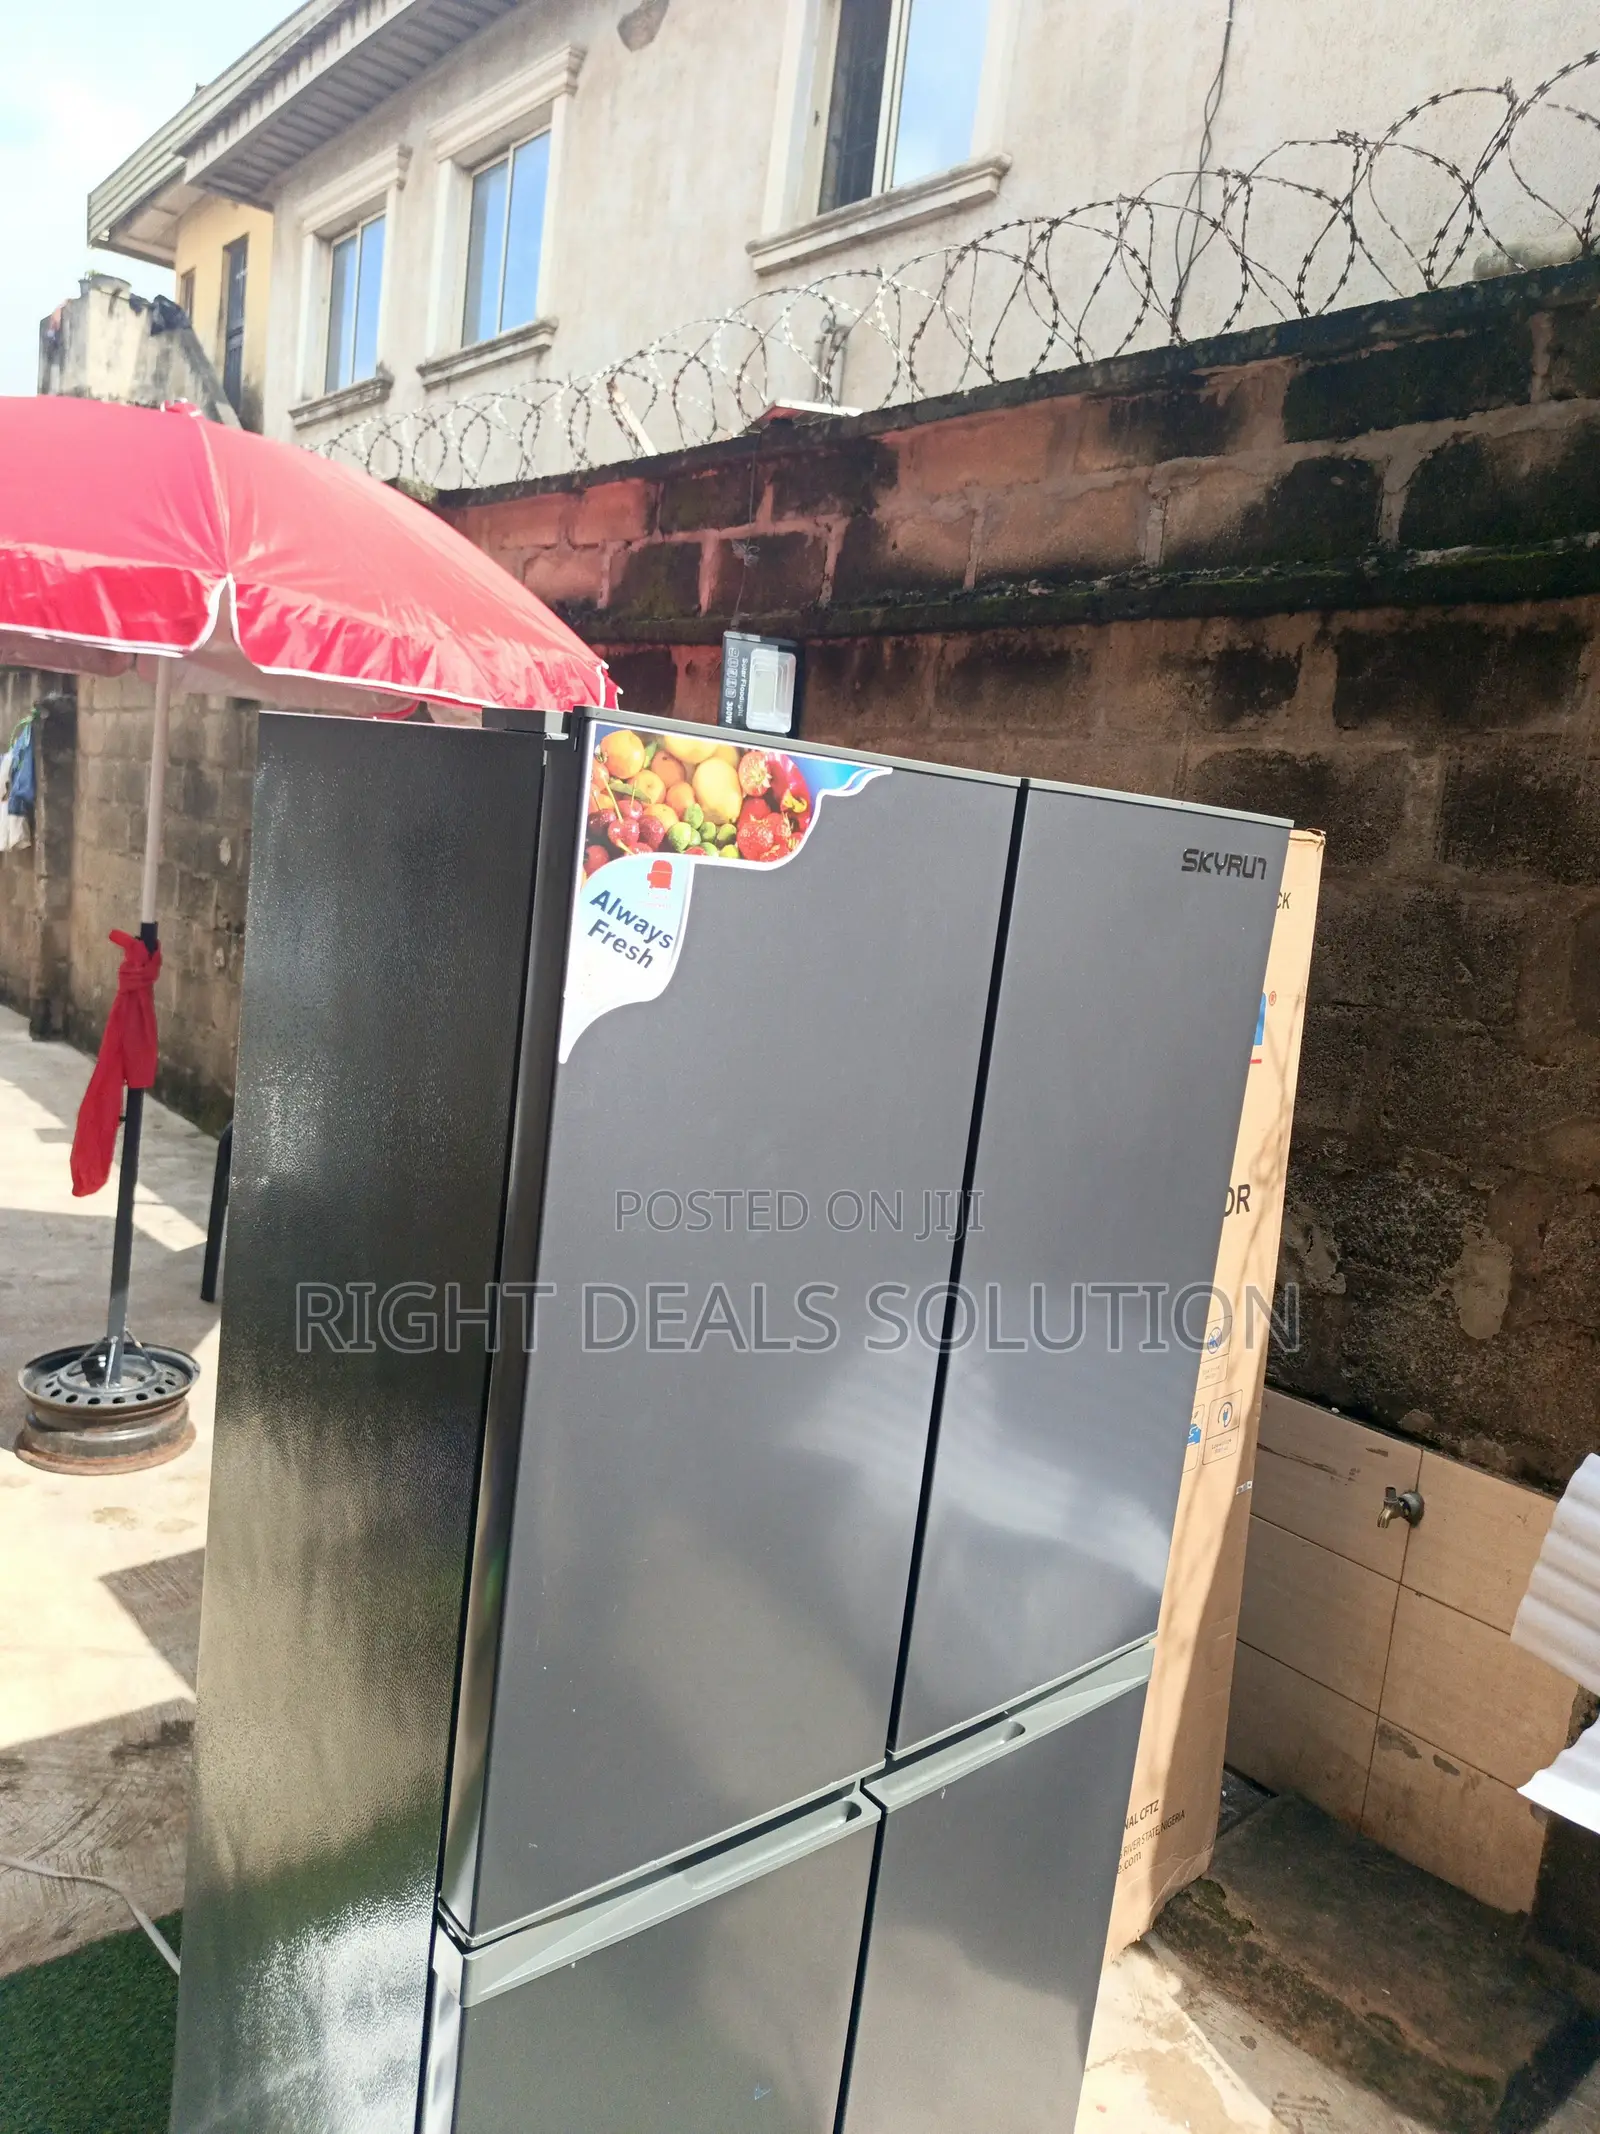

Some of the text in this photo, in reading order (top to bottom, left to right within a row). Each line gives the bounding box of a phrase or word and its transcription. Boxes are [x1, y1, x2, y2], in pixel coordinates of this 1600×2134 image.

[725, 701, 734, 724] 300W
[1181, 848, 1267, 880] SKYRUN
[589, 889, 674, 949] Always
[587, 918, 654, 969] Fresh
[1139, 1799, 1159, 1820] CFTZ
[1123, 1837, 1141, 1857] RIVER
